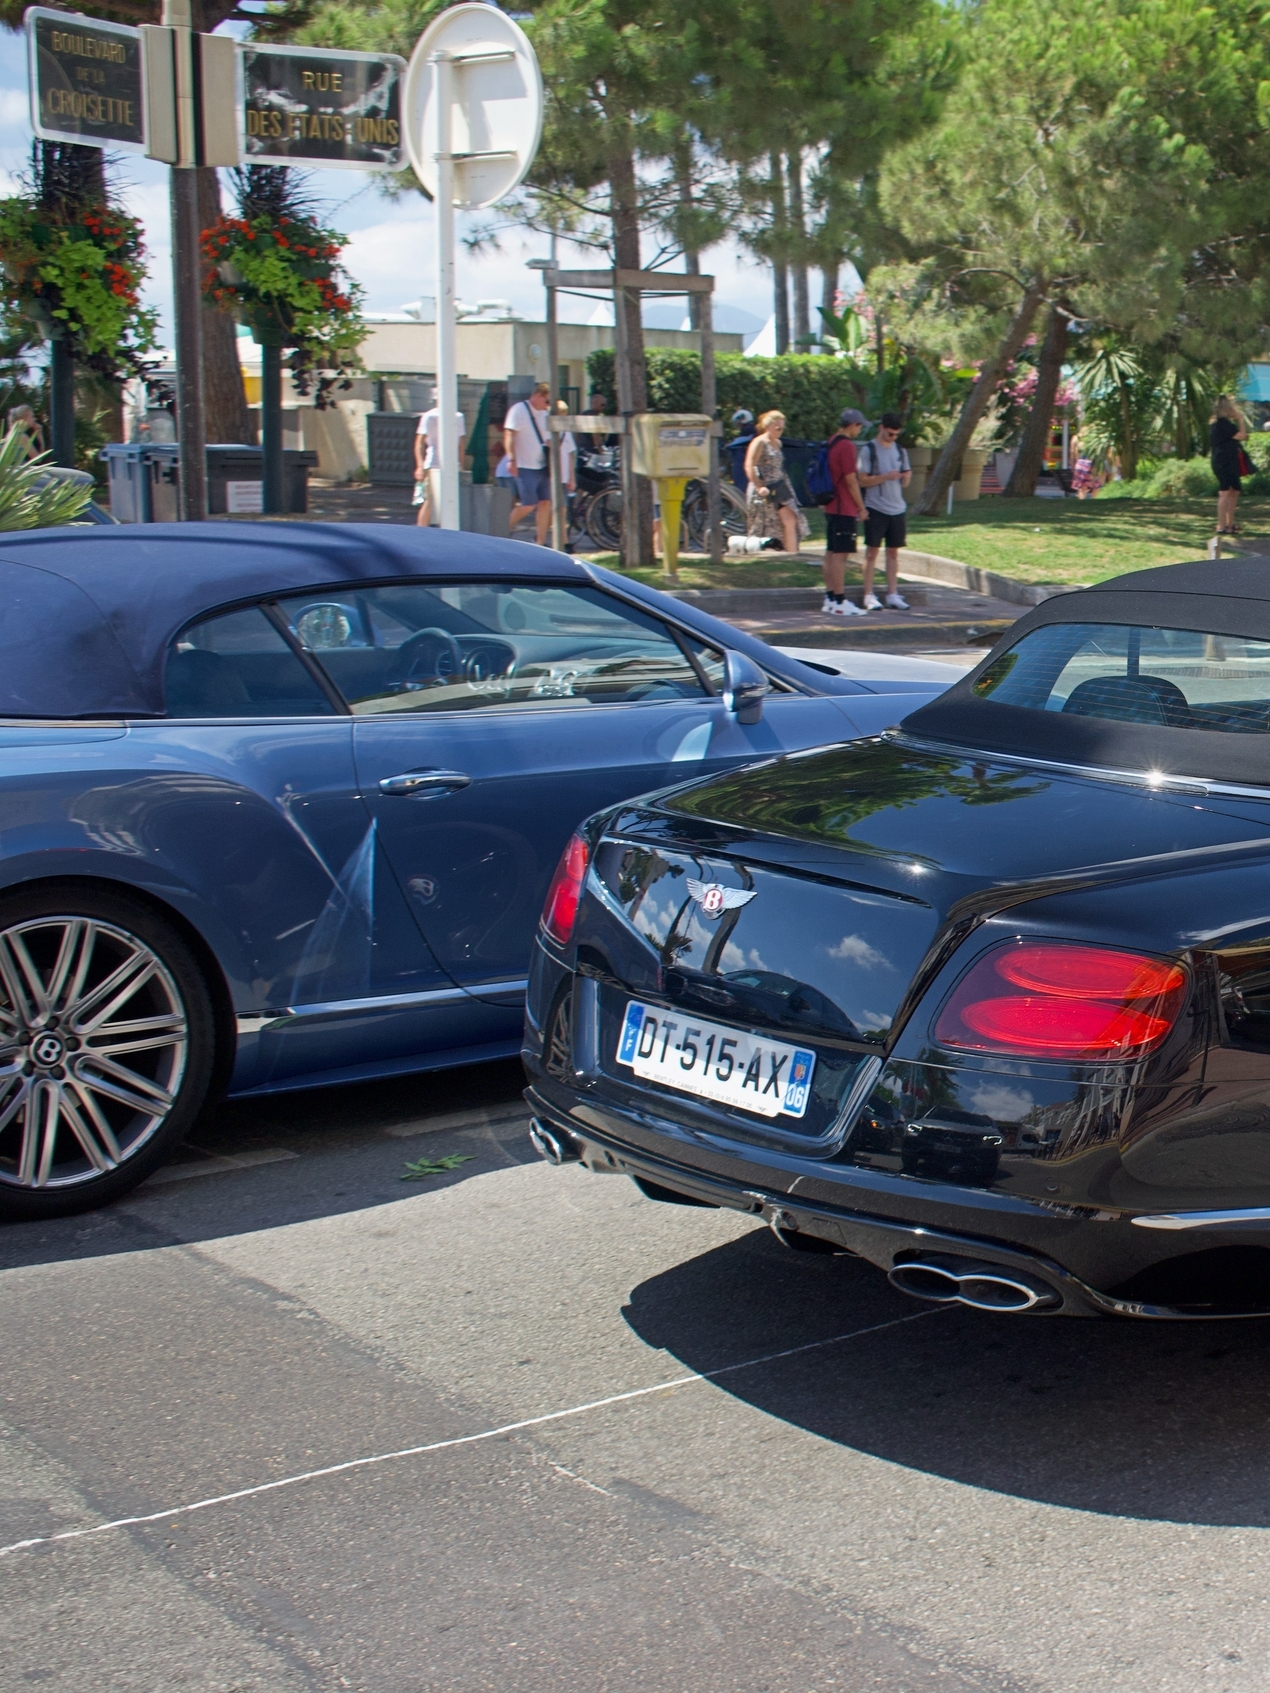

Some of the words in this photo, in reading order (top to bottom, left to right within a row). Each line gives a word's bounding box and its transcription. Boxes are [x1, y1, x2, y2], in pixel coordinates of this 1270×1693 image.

[51, 30, 126, 64] BOULEVARD
[75, 66, 89, 82] DE
[92, 69, 106, 85] LA
[302, 71, 343, 93] RUE
[46, 87, 135, 127] CROISETTE
[247, 109, 282, 138] DES
[624, 1040, 633, 1052] F
[637, 1016, 789, 1099] DT-515-AX
[786, 1083, 804, 1108] 06
